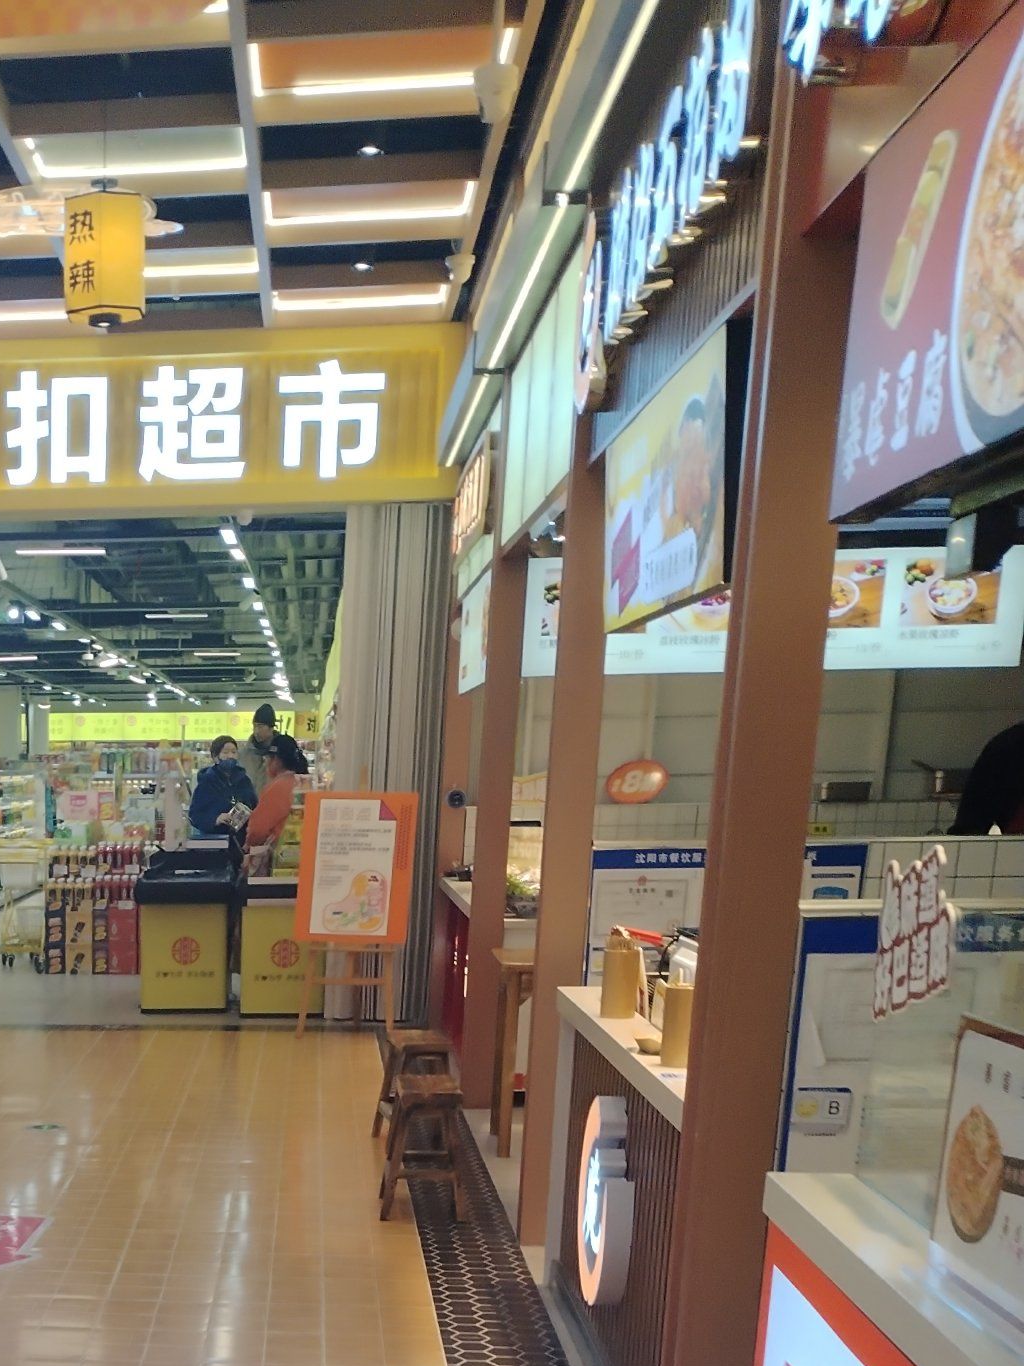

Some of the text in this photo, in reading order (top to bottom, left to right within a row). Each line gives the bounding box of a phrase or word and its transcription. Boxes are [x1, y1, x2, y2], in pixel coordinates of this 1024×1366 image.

[68, 207, 96, 294] 热辣
[634, 851, 707, 864] 沈阳市餐饮服
[828, 1100, 840, 1115] B
